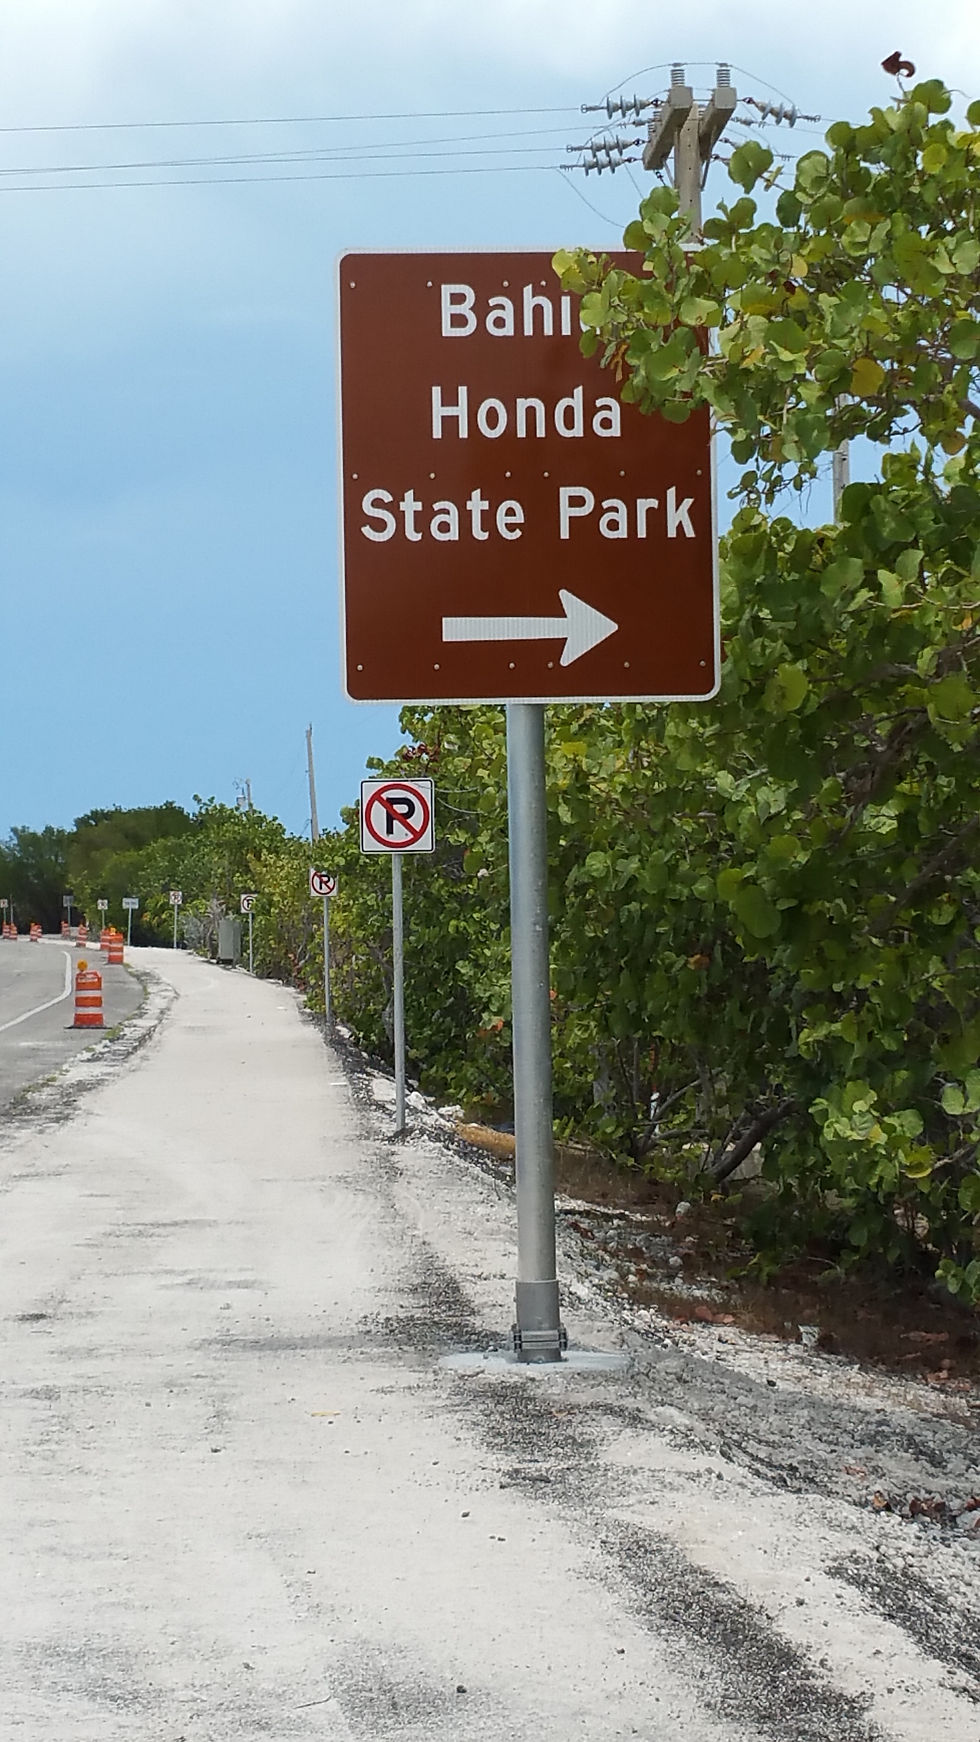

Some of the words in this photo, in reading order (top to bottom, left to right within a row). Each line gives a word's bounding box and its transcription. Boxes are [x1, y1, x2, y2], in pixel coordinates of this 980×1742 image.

[440, 283, 600, 337] Bahi
[431, 385, 621, 439] Honda
[360, 487, 525, 542] State
[559, 486, 696, 540] Park
[386, 797, 415, 835] P
